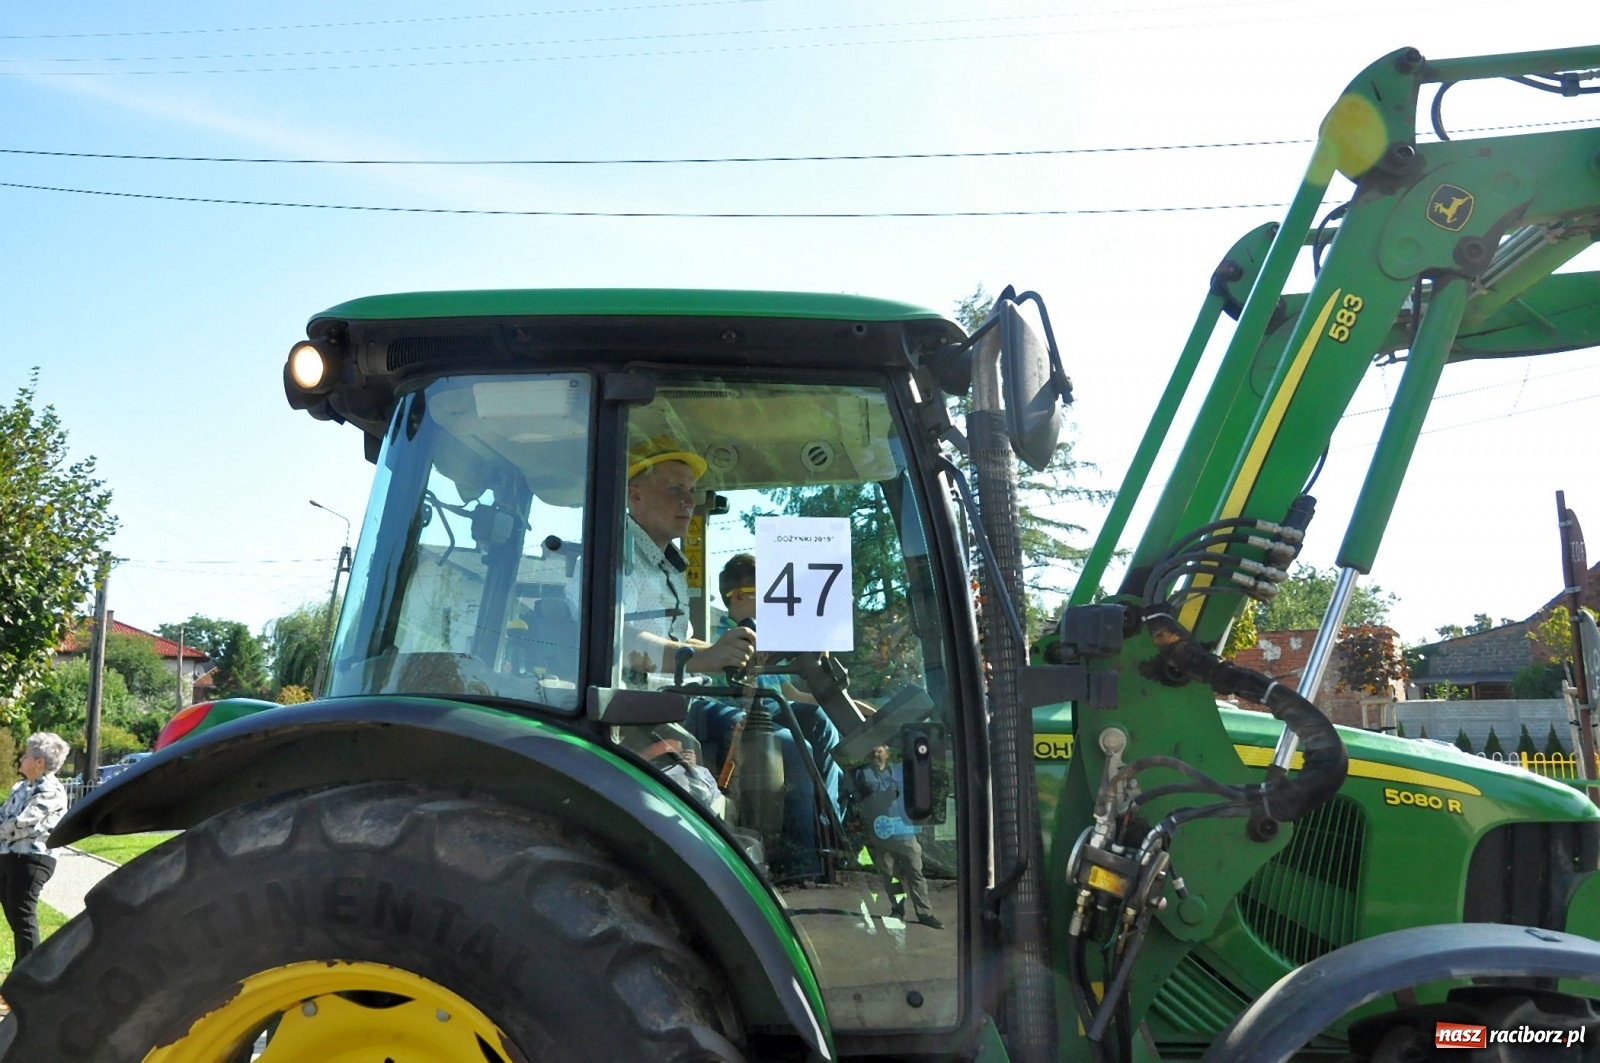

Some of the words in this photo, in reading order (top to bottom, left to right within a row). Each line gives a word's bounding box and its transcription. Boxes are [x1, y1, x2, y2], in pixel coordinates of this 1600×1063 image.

[1328, 293, 1363, 342] 583
[763, 561, 844, 617] 47
[1034, 741, 1074, 757] OH
[1384, 787, 1443, 810] 5080
[1447, 798, 1463, 814] R
